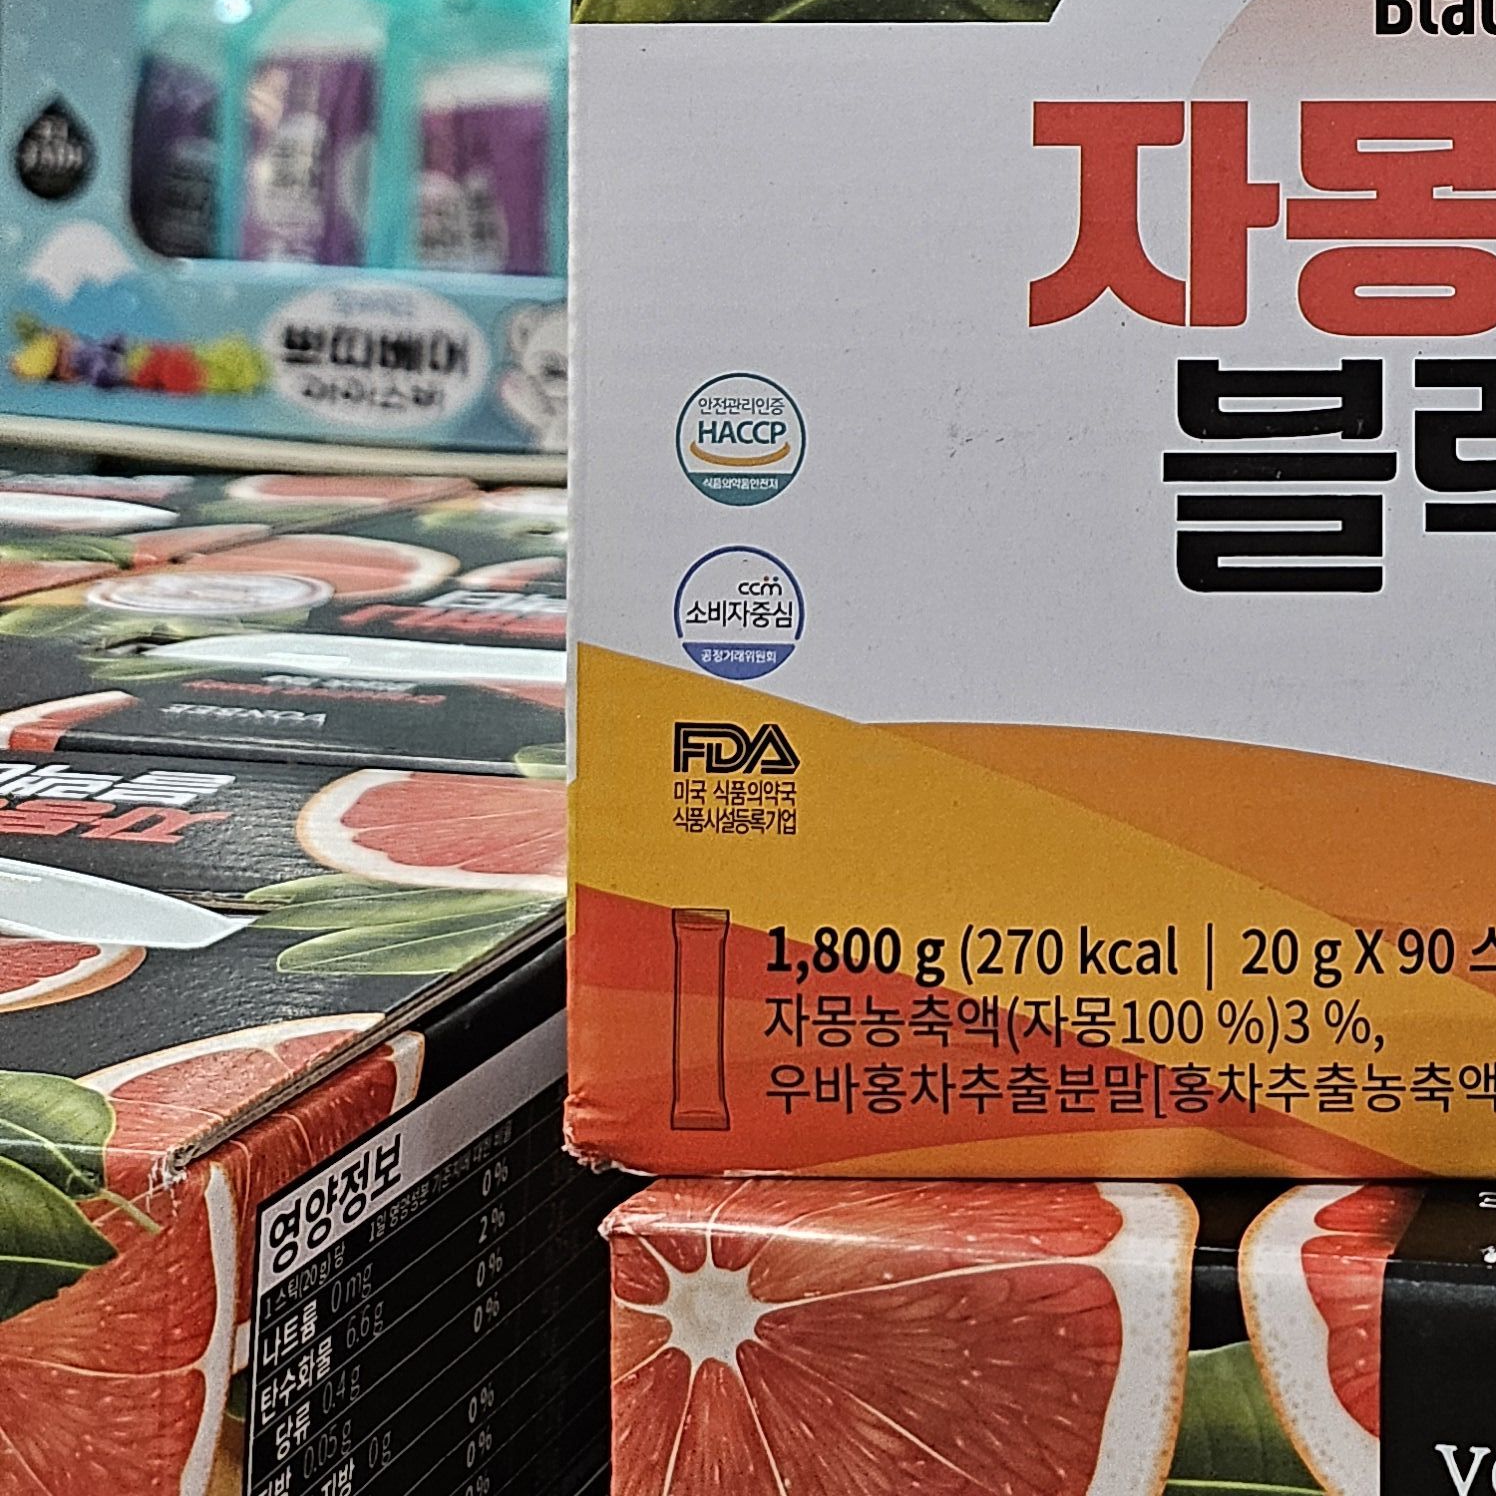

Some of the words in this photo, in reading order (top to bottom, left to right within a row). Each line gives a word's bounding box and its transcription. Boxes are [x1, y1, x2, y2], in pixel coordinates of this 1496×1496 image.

[698, 397, 785, 415] 안전관리인증
[698, 420, 787, 444] HACCP
[685, 600, 793, 628] 소비자중심
[701, 648, 777, 663] 공정거래위원회
[674, 722, 801, 774] FDA
[673, 778, 708, 806] 미국
[712, 779, 798, 807] 식품의약국
[672, 806, 797, 835] 식품시설등록기업
[766, 925, 902, 985] 1,800
[914, 936, 946, 988] g
[960, 923, 1064, 986] (270
[1079, 925, 1179, 976] kcal
[1240, 928, 1300, 976] 20
[1312, 938, 1344, 989] g
[1354, 929, 1385, 975] X
[1397, 928, 1456, 976] 90
[763, 994, 1205, 1055] 자몽농축액(자몽100
[269, 1132, 402, 1274] 영양정보
[262, 1298, 318, 1366] 나트륨
[260, 1335, 333, 1426] 탄수화물
[275, 1400, 311, 1461] 당류
